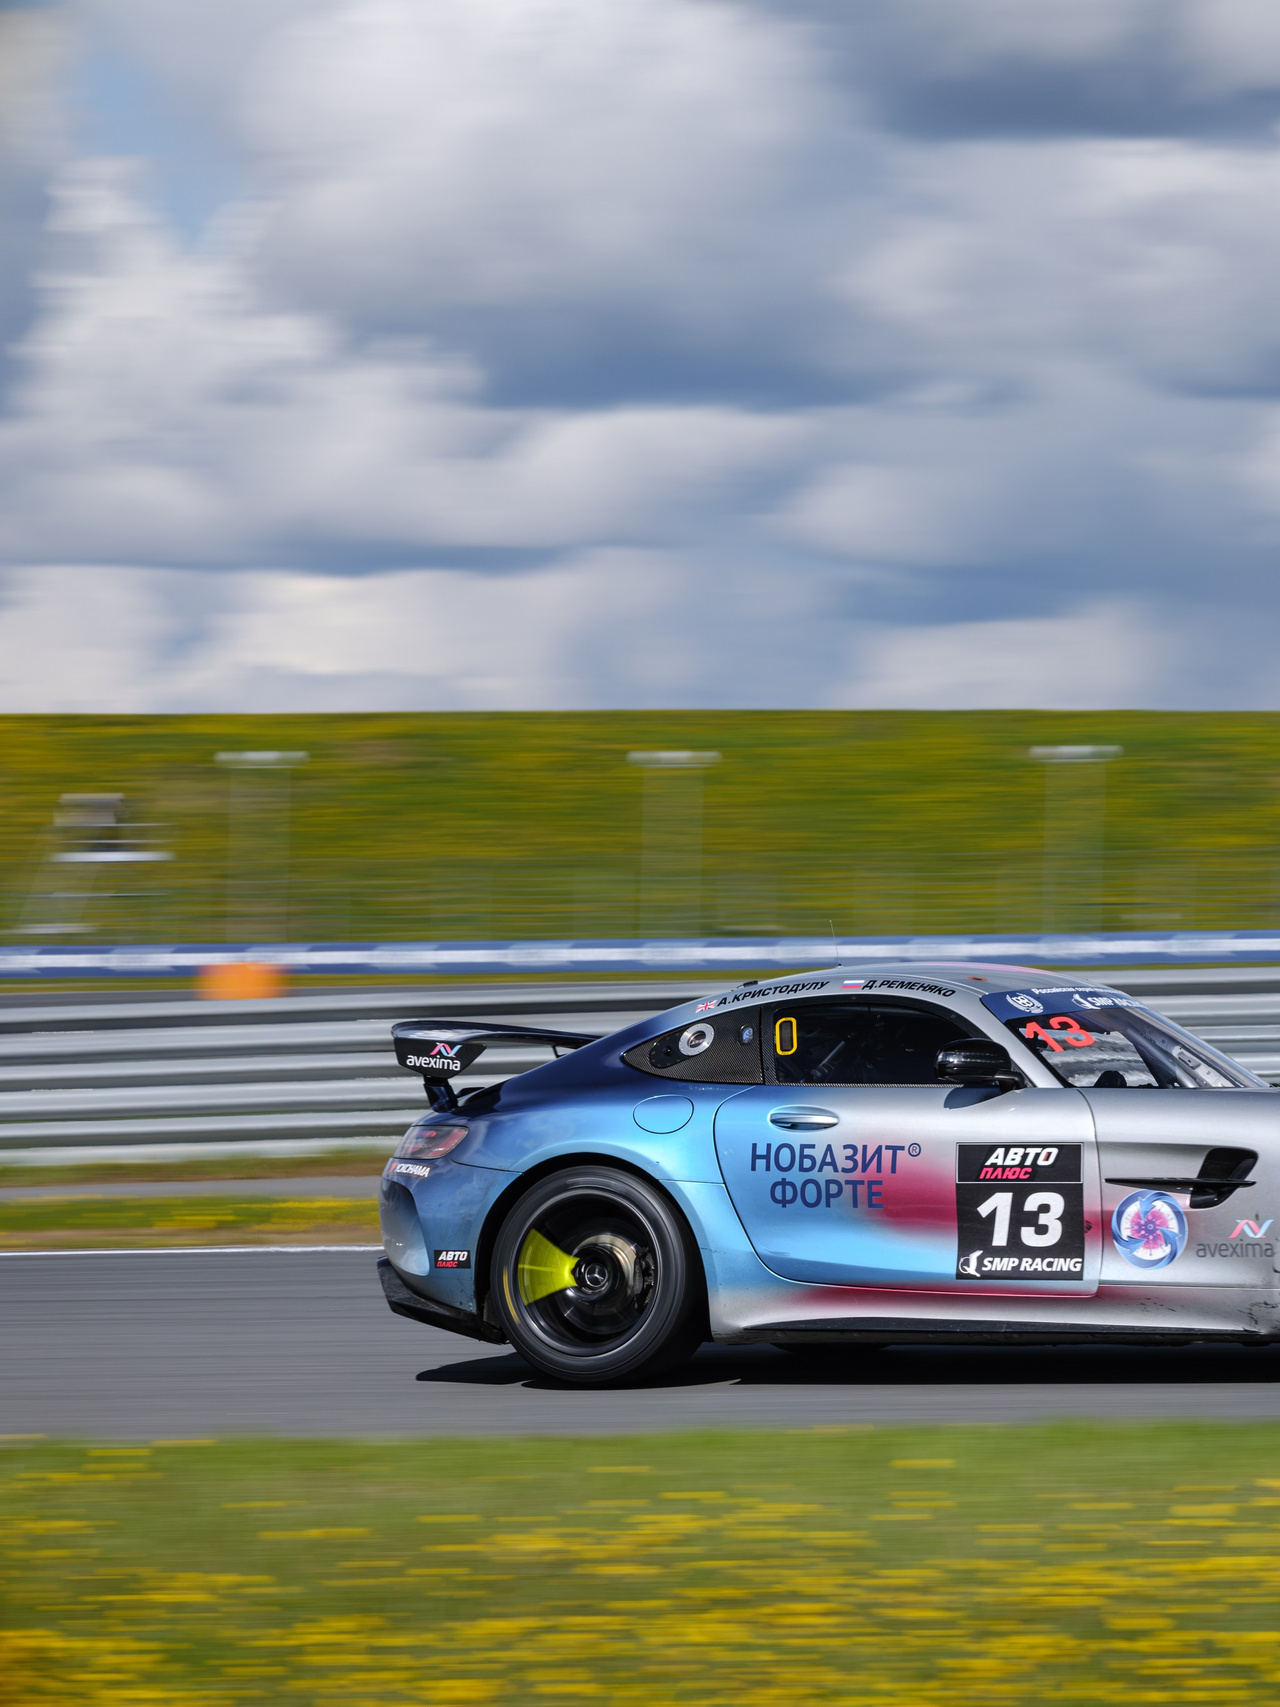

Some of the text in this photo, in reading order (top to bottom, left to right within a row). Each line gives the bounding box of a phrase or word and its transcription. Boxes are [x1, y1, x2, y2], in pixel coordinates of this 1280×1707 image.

[717, 980, 830, 1007] А.КРИСТОДУЛУ
[862, 980, 956, 998] Д.РЕМЕНЯКО
[1024, 1016, 1096, 1053] 13
[406, 1055, 461, 1071] avexima
[984, 1147, 1059, 1166] АВТО
[979, 1167, 1033, 1179] ПЛЮС
[770, 1178, 884, 1209] ФОРТЕ
[976, 1192, 1065, 1247] 13
[438, 1251, 469, 1261] АВТО
[1196, 1242, 1274, 1258] avexima
[981, 1257, 1082, 1272] SMP RACING
